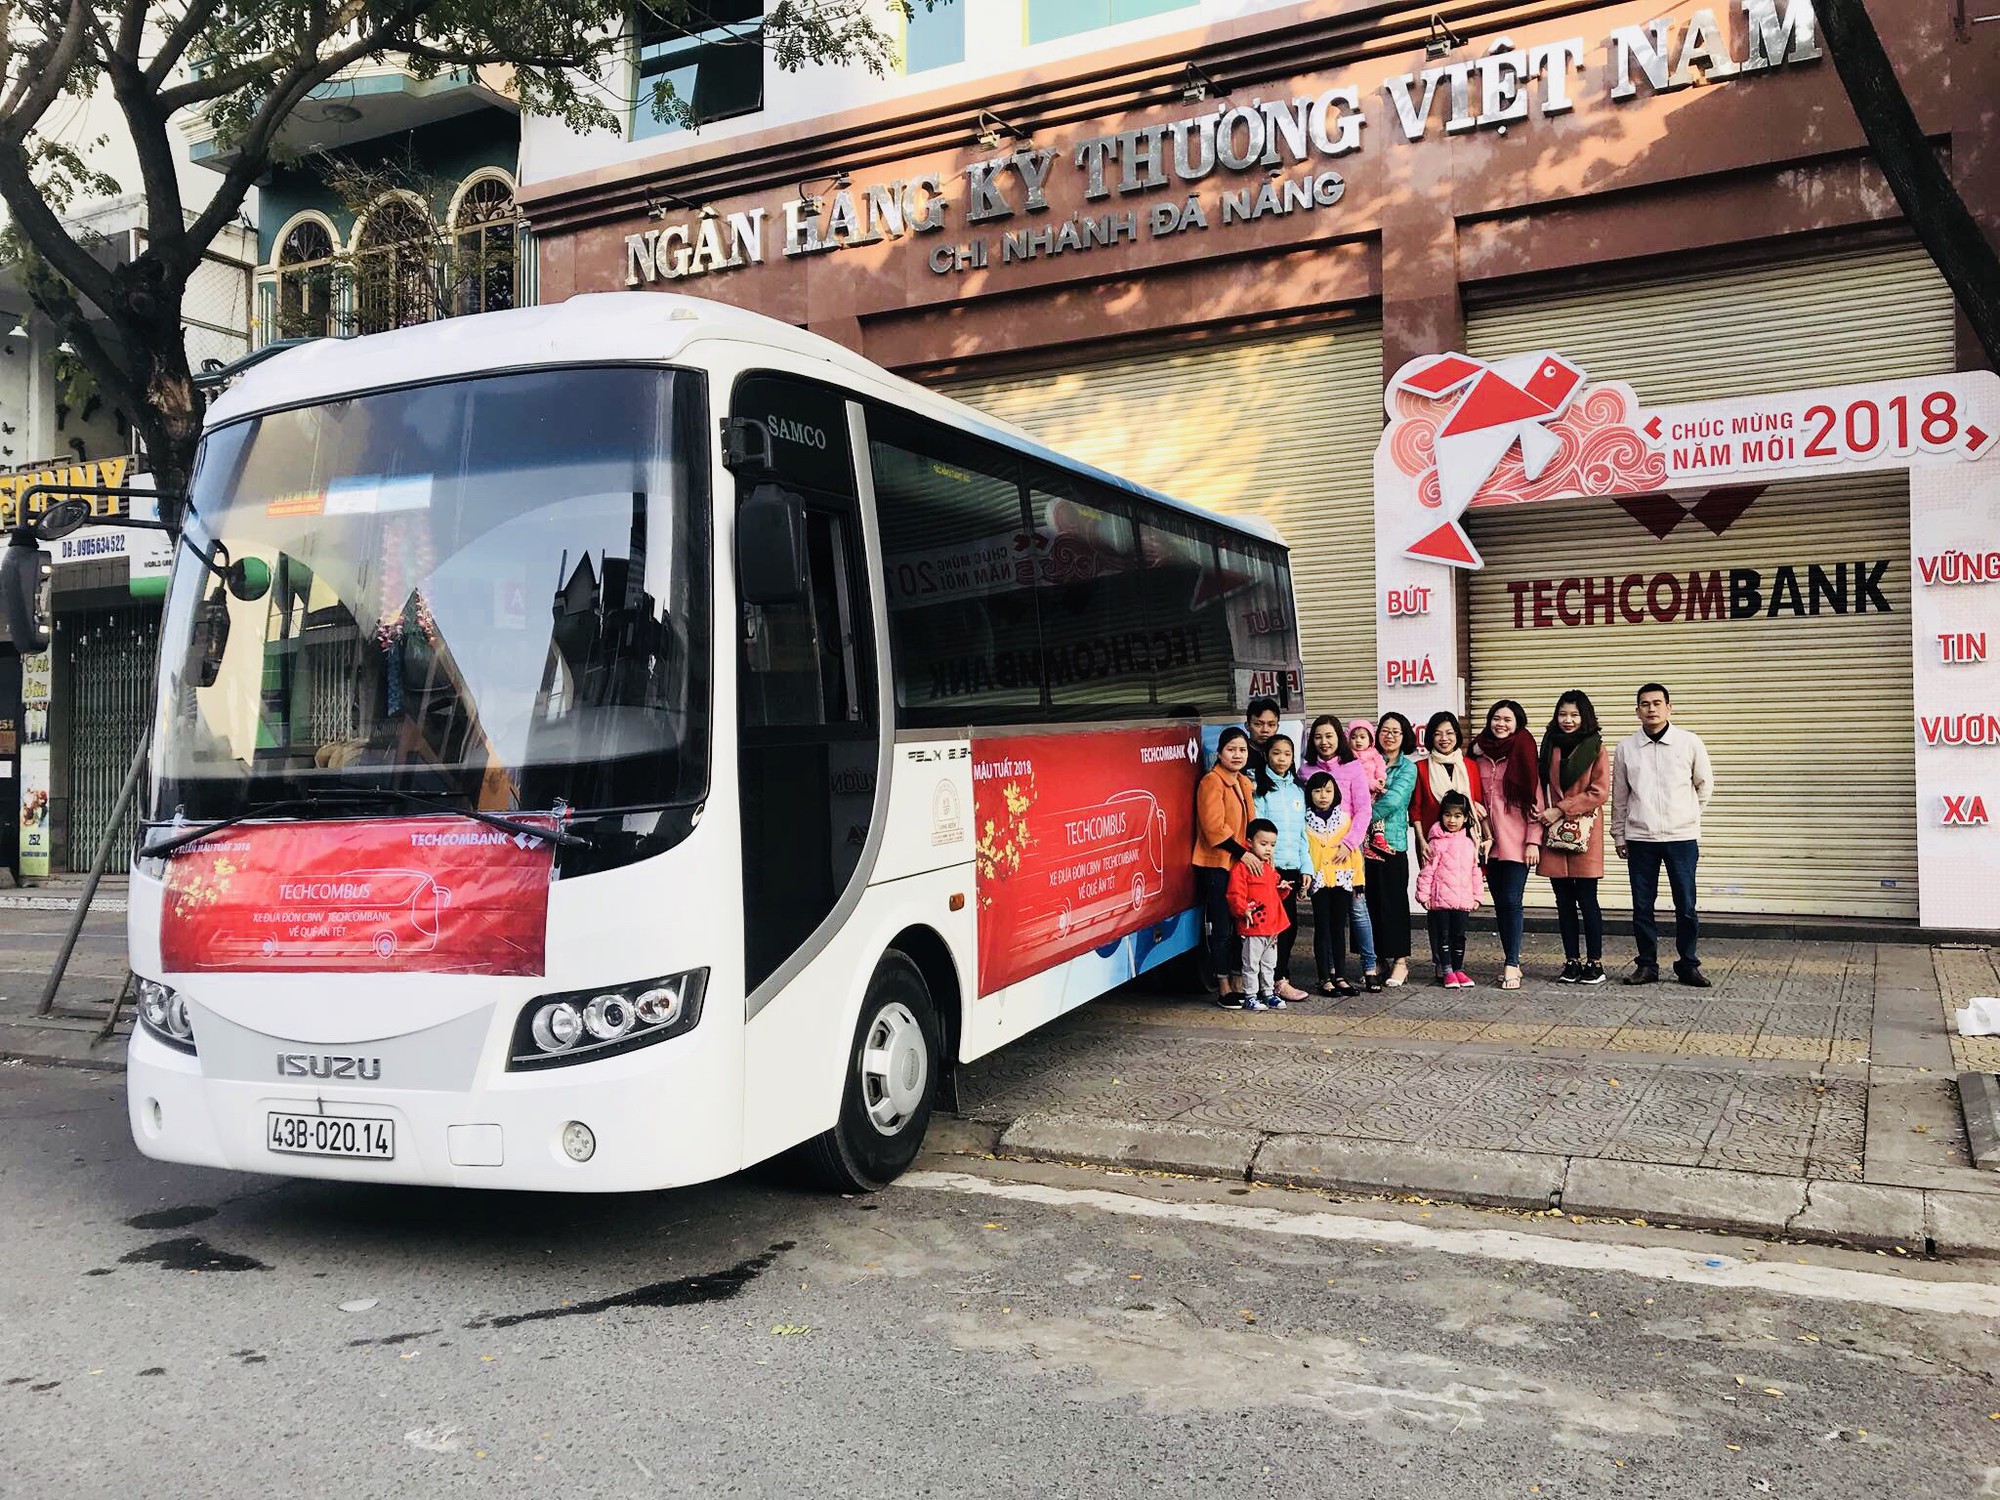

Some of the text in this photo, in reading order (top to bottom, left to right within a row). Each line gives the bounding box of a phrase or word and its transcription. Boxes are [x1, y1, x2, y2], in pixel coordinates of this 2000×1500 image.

[625, 205, 766, 288] NGÂN
[1075, 83, 1367, 200] THƯƠNG
[1383, 35, 1585, 142] VIỆT
[1610, 0, 1823, 100] NAM
[929, 237, 989, 274] CHI
[1002, 209, 1138, 264] NHÁNH
[767, 414, 827, 450] SAMCO
[1672, 411, 1793, 441] CHÚC MỪNG
[1802, 390, 1959, 459] 2018
[1673, 433, 1794, 471] NĂM MỚI
[1918, 549, 2000, 583] VỮNG
[1387, 584, 1431, 613] BỨT
[1506, 559, 1893, 629] TECHCOMBANK
[1937, 632, 1986, 661] TIN
[1386, 653, 1435, 684] PHÁ
[1013, 759, 1032, 776] 2018
[1140, 744, 1186, 764] TECHCOMBANK
[1943, 795, 1989, 822] XA
[28, 834, 41, 846] 252
[410, 832, 509, 846] TECHCOMBANK
[1064, 812, 1127, 845] TECHCOMBUS
[279, 883, 372, 900] TECHCOMBUS
[328, 911, 391, 923] TECHCOMBANK
[277, 1052, 381, 1080] ISUZU
[272, 1117, 388, 1154] 43B-020.14
